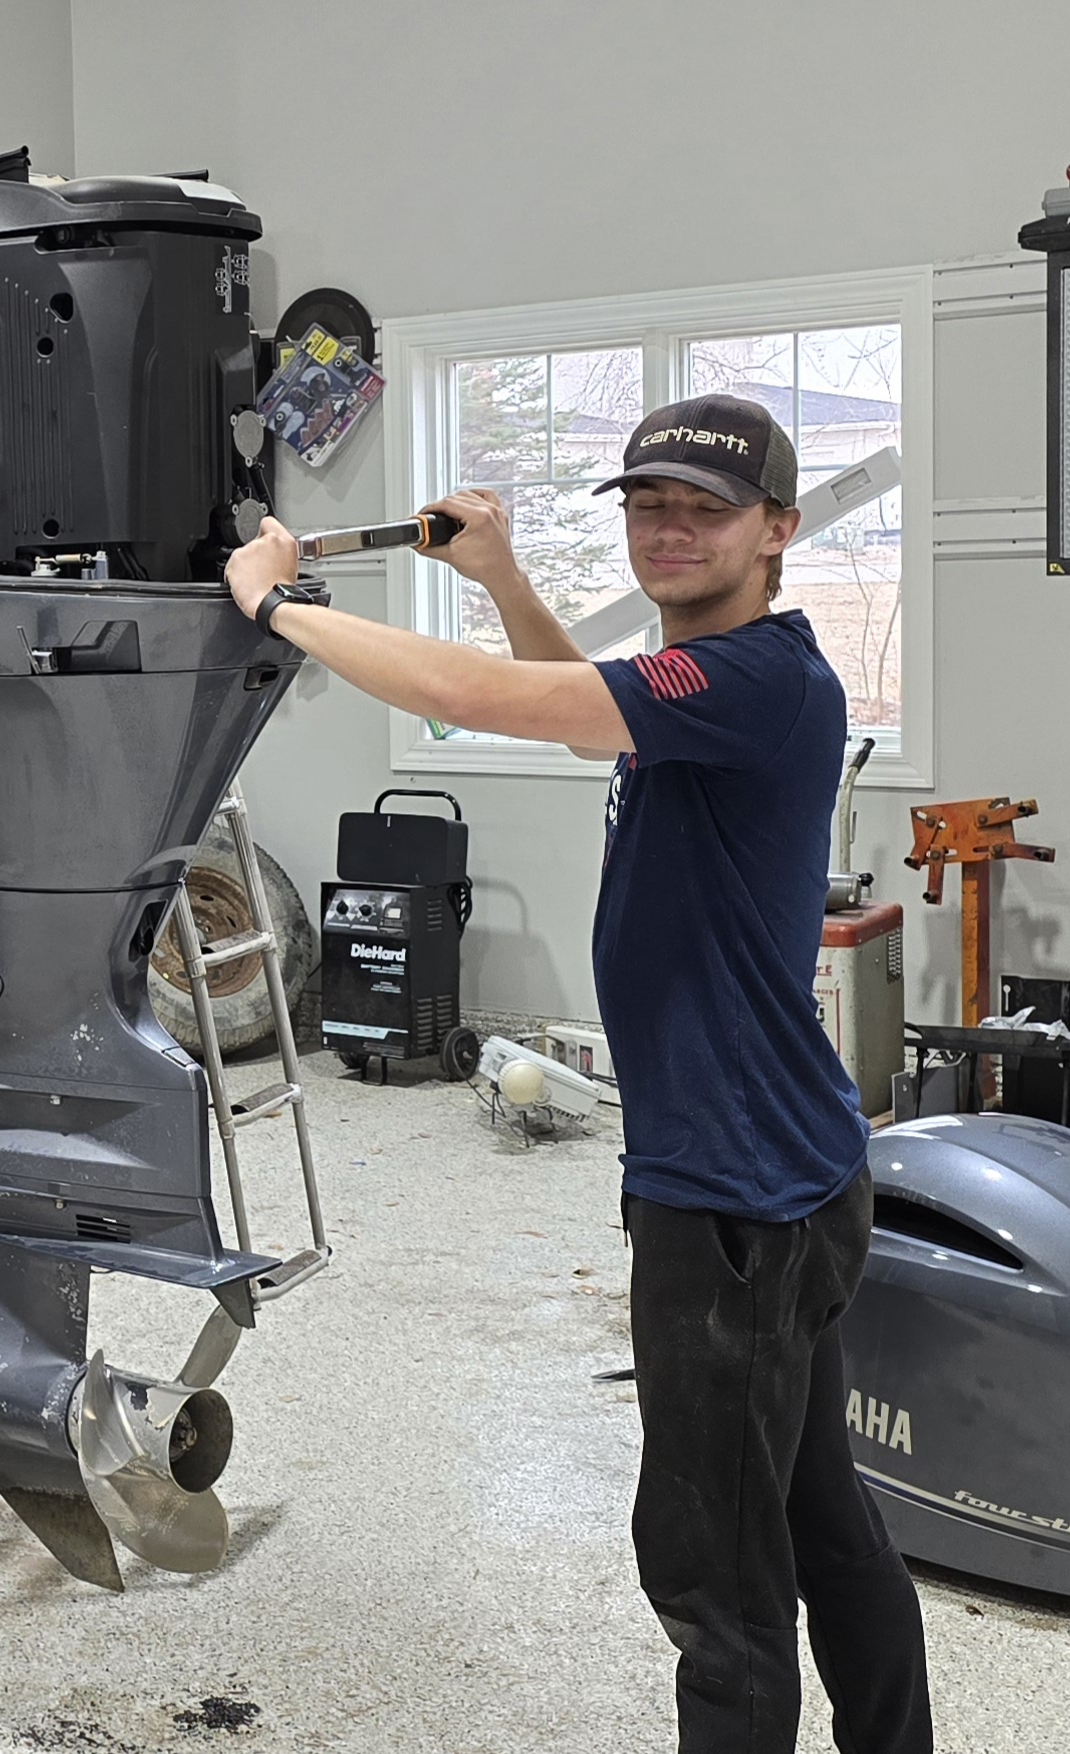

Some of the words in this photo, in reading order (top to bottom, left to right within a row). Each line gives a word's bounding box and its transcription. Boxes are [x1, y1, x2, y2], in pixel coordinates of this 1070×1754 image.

[640, 426, 748, 454] carhartt
[351, 943, 406, 962] DieHard
[846, 1388, 912, 1455] AHA
